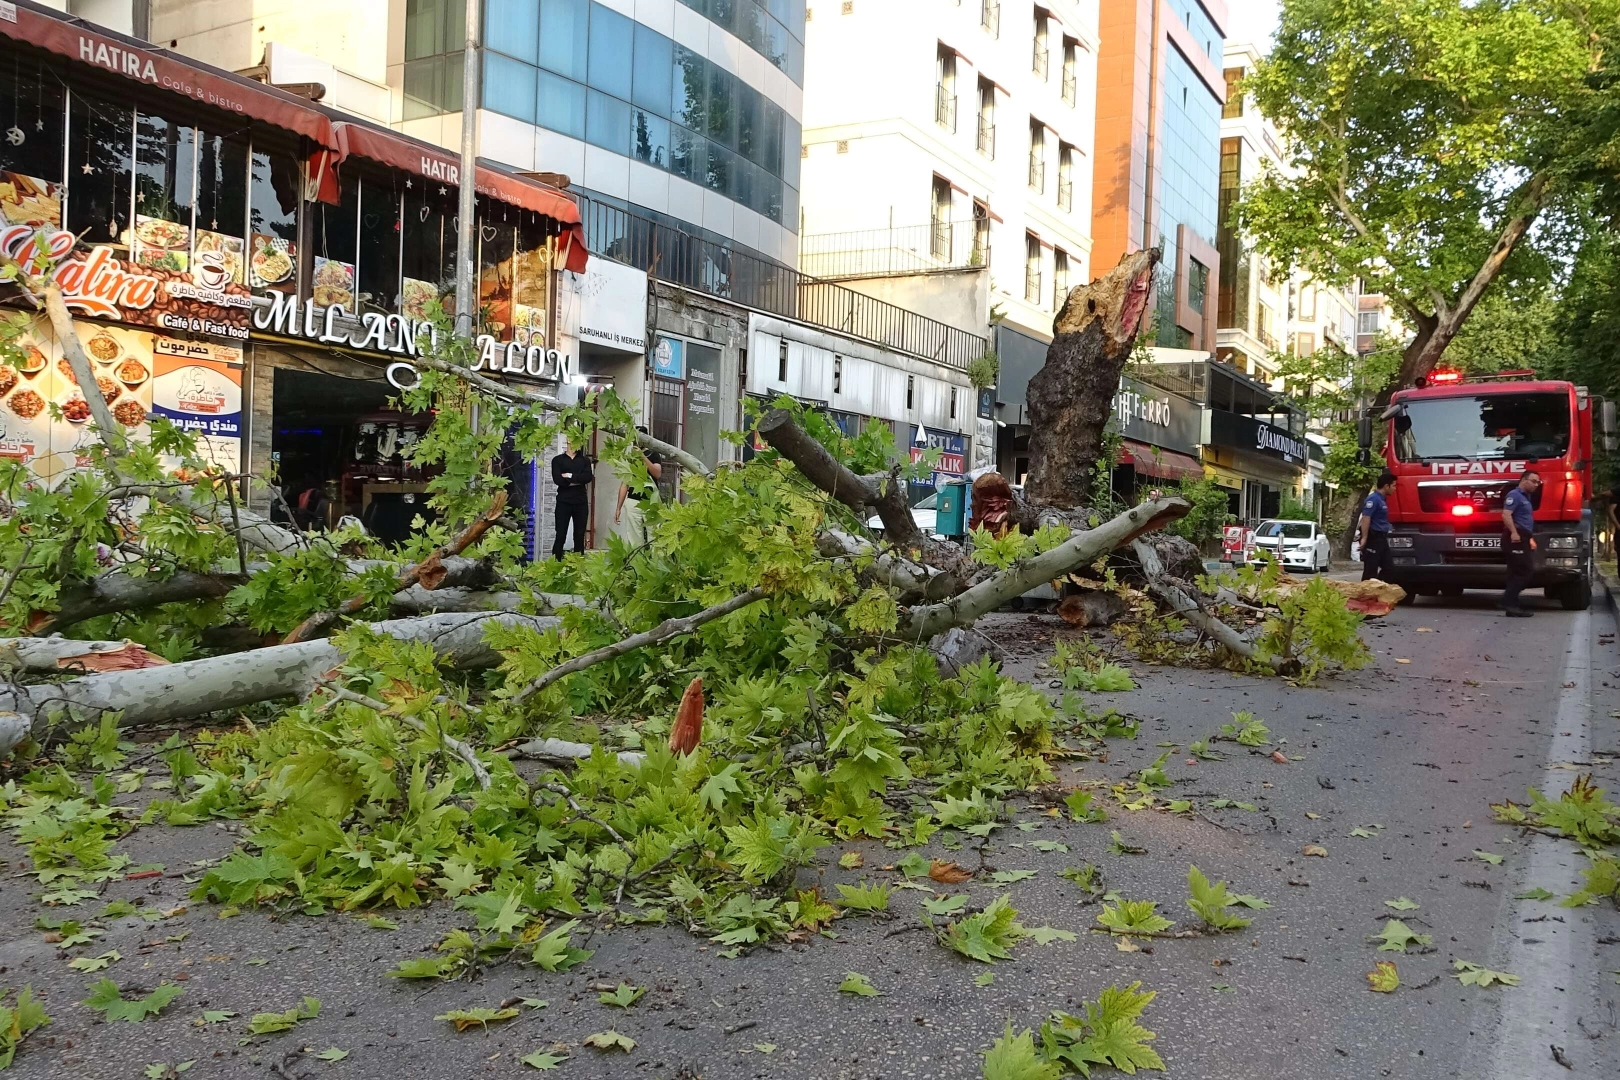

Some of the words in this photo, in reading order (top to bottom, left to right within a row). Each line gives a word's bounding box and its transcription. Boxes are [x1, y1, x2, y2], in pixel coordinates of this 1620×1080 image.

[79, 36, 159, 83] HATIRA
[162, 76, 192, 94] Cafe
[196, 87, 205, 99] &
[208, 91, 244, 112] bistro
[421, 156, 460, 184] HATIR
[164, 316, 188, 329] Café
[192, 321, 200, 331] &
[205, 322, 226, 335] Fast
[228, 327, 250, 339] food
[579, 326, 613, 341] SARUHANLI
[468, 334, 572, 385] ALON
[209, 419, 238, 436] مندي
[1256, 424, 1290, 453] DIAMOND
